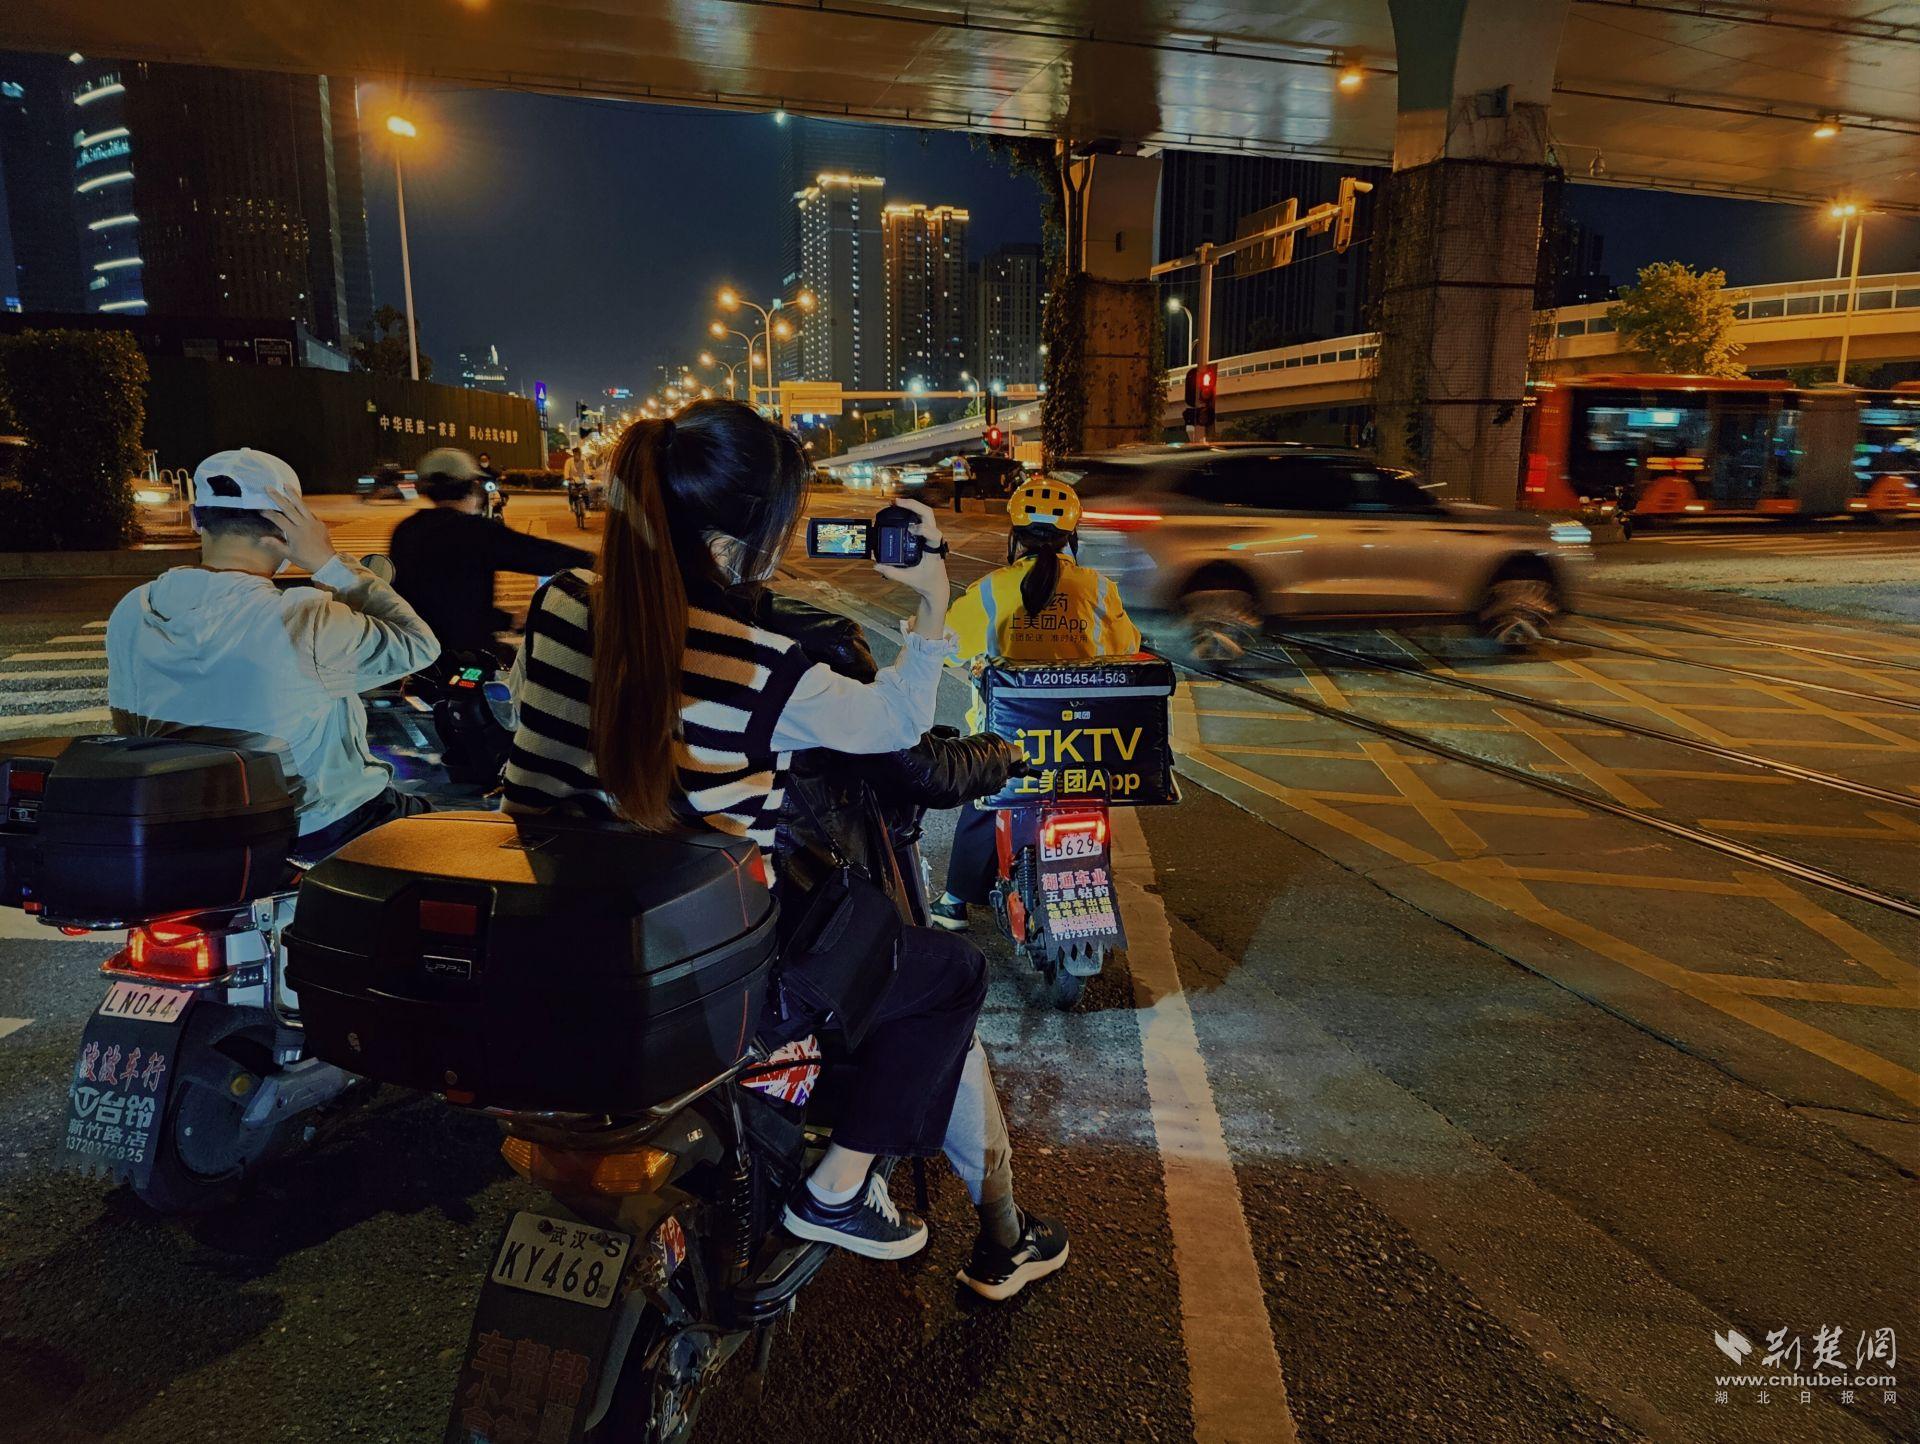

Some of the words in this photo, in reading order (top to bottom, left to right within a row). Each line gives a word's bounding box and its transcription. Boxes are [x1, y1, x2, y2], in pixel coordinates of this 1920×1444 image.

[1008, 612, 1088, 633] 上美团App
[1032, 672, 1127, 685] A2015454-503
[104, 989, 179, 1017] LN044
[68, 1118, 149, 1149] 新竹路店
[549, 1225, 588, 1250] 武汉
[498, 1240, 605, 1298] KY468
